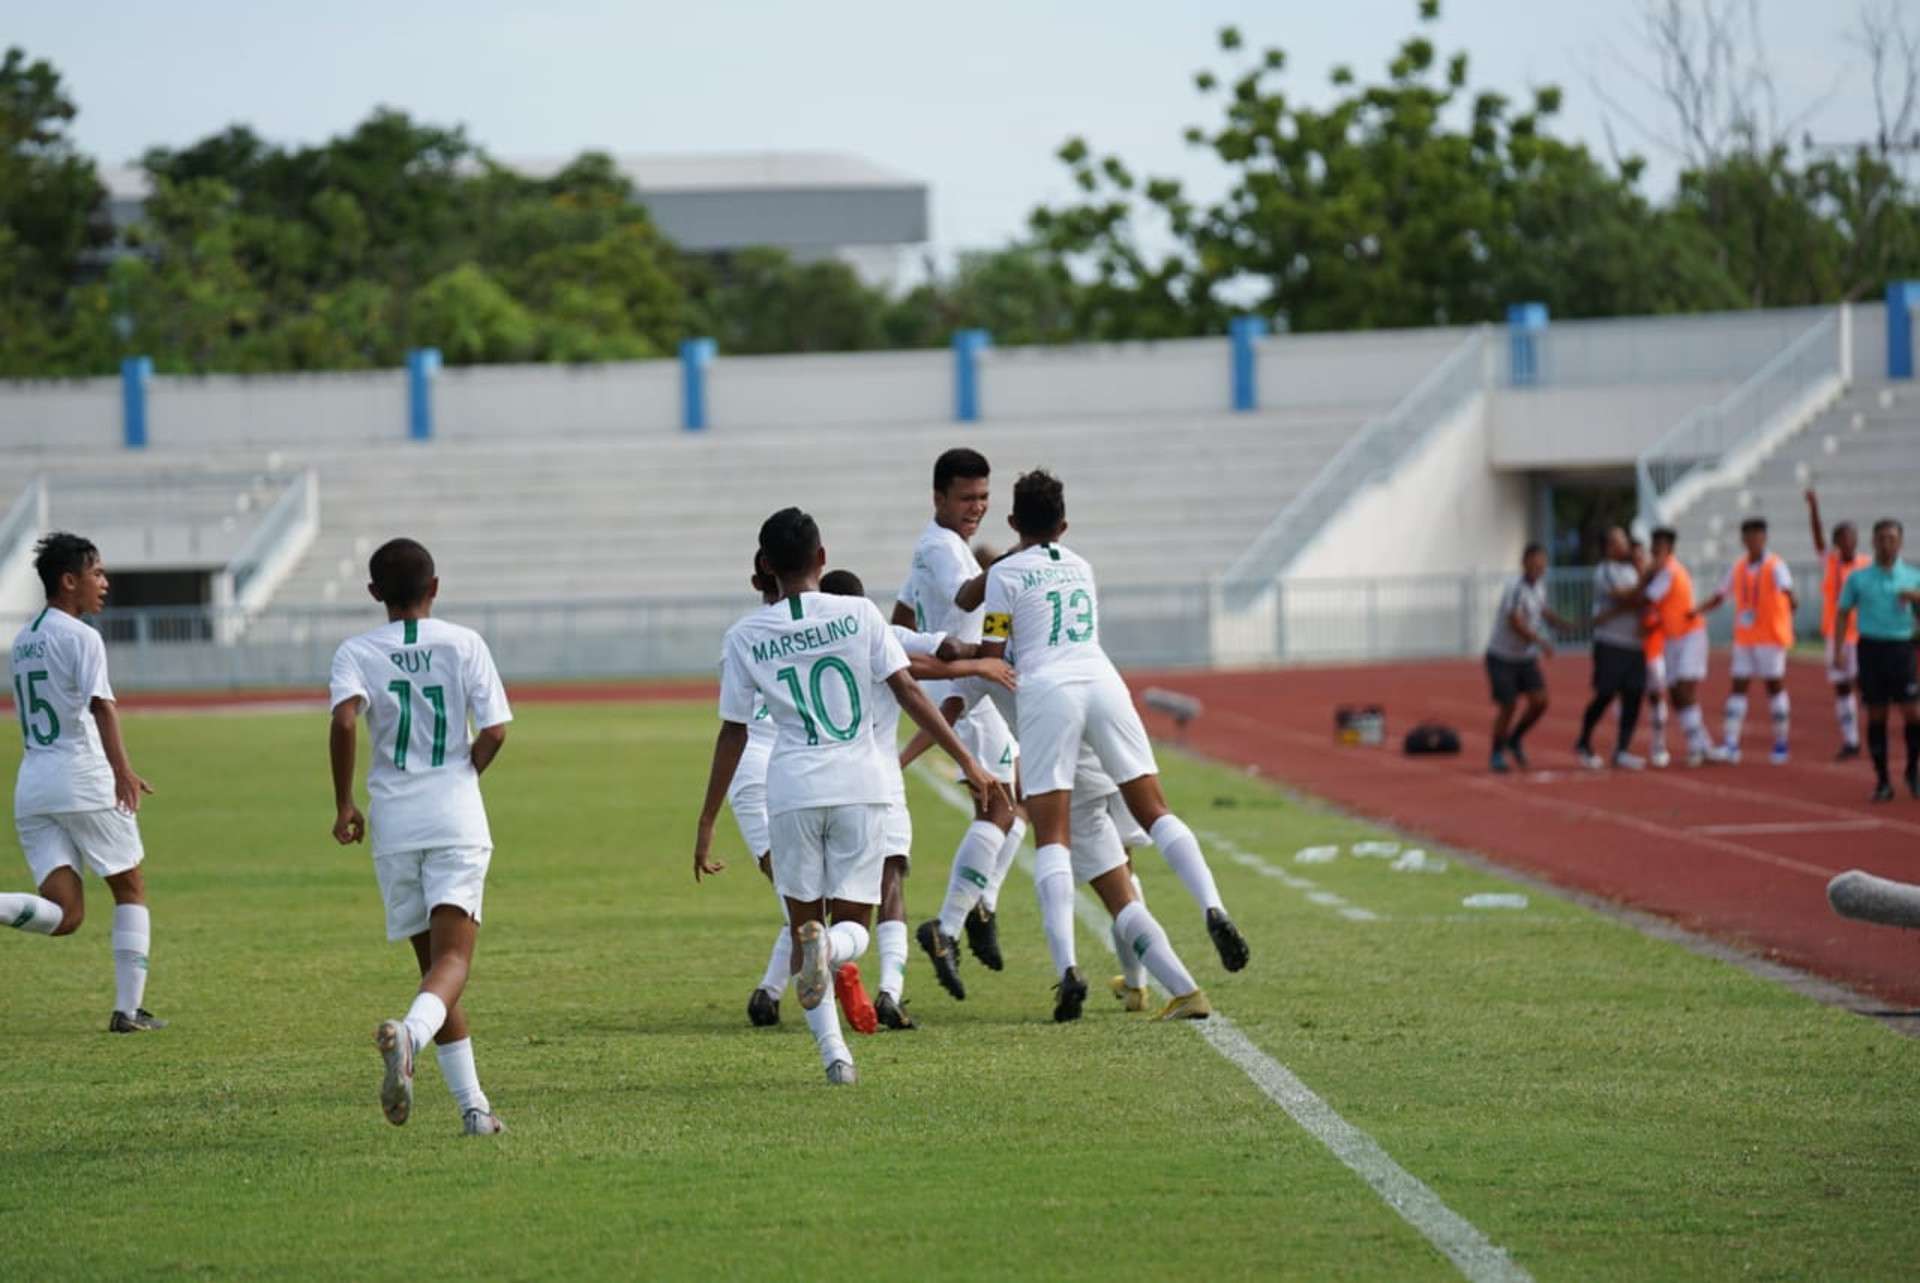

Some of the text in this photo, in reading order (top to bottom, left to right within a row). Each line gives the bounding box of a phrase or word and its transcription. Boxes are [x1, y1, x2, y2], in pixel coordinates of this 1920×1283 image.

[751, 615, 859, 664] MARSELINO
[983, 614, 996, 634] C
[1046, 588, 1094, 646] 13
[390, 649, 432, 673] RUY
[14, 670, 61, 749] 15
[387, 679, 447, 772] 11
[776, 655, 862, 746] 10
[998, 742, 1014, 768] 4
